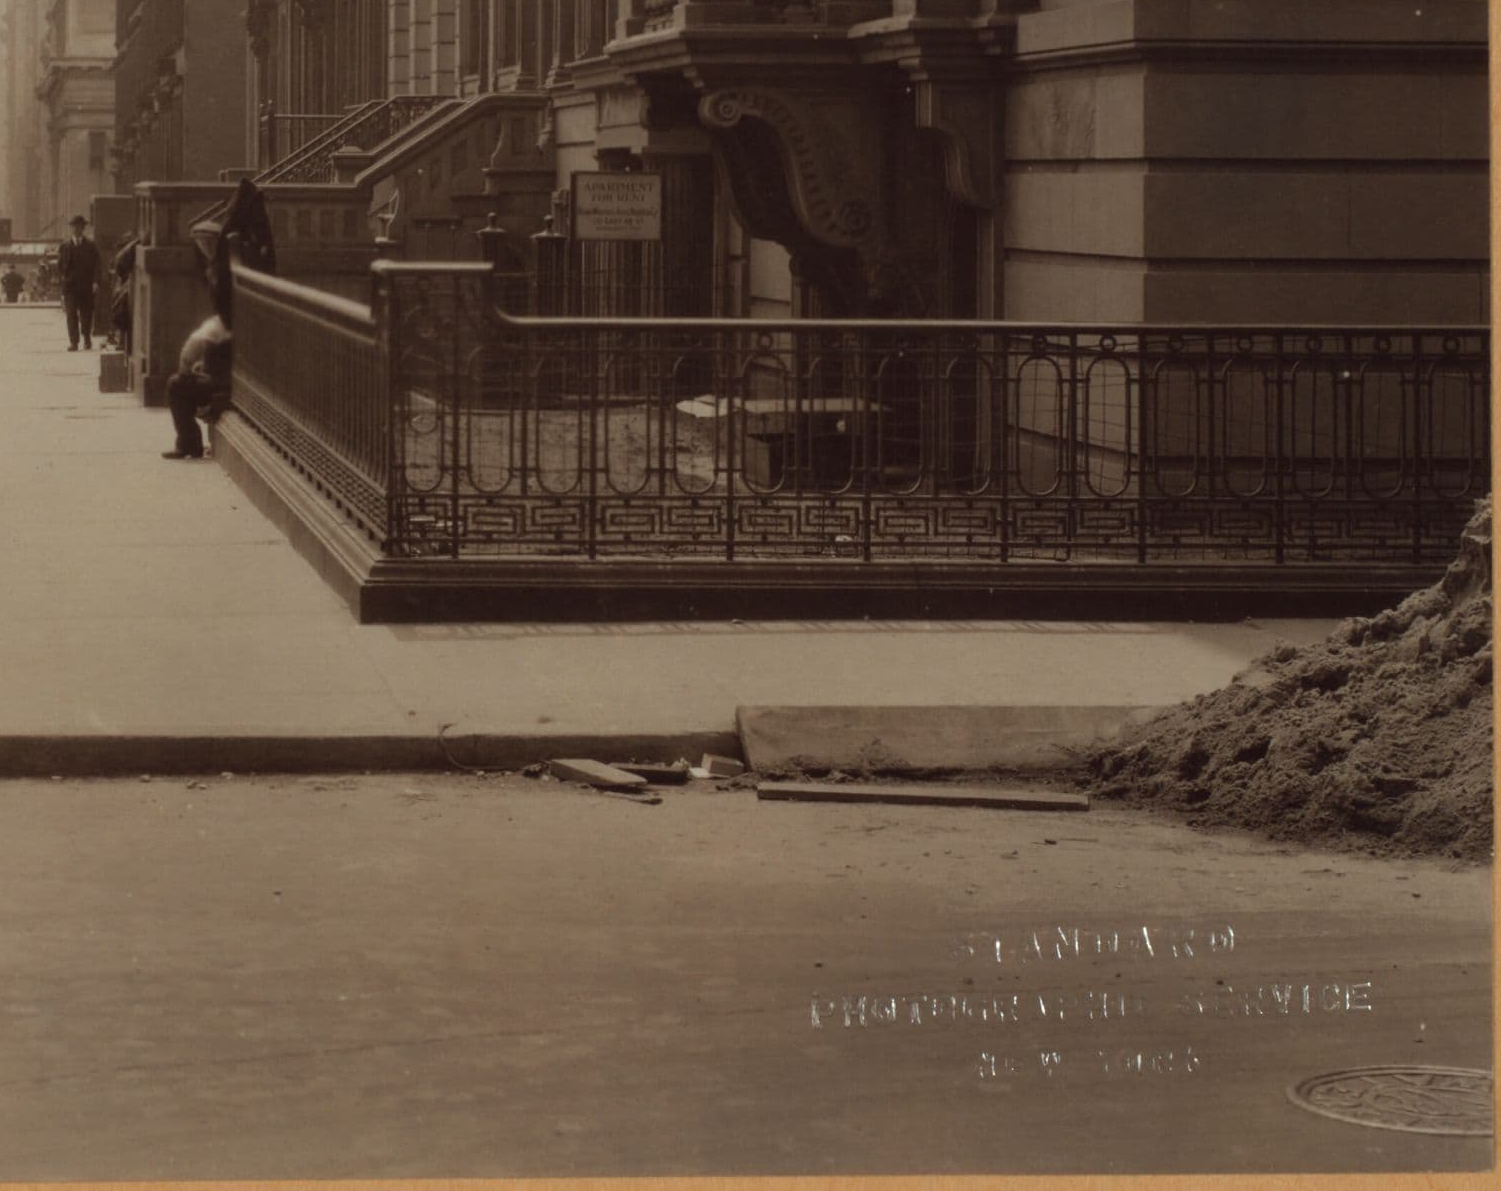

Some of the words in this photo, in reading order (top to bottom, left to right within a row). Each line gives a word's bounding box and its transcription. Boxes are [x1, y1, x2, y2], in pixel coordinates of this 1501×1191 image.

[585, 182, 653, 192] APARTMENT
[591, 192, 613, 202] FOR
[616, 192, 645, 202] RENT
